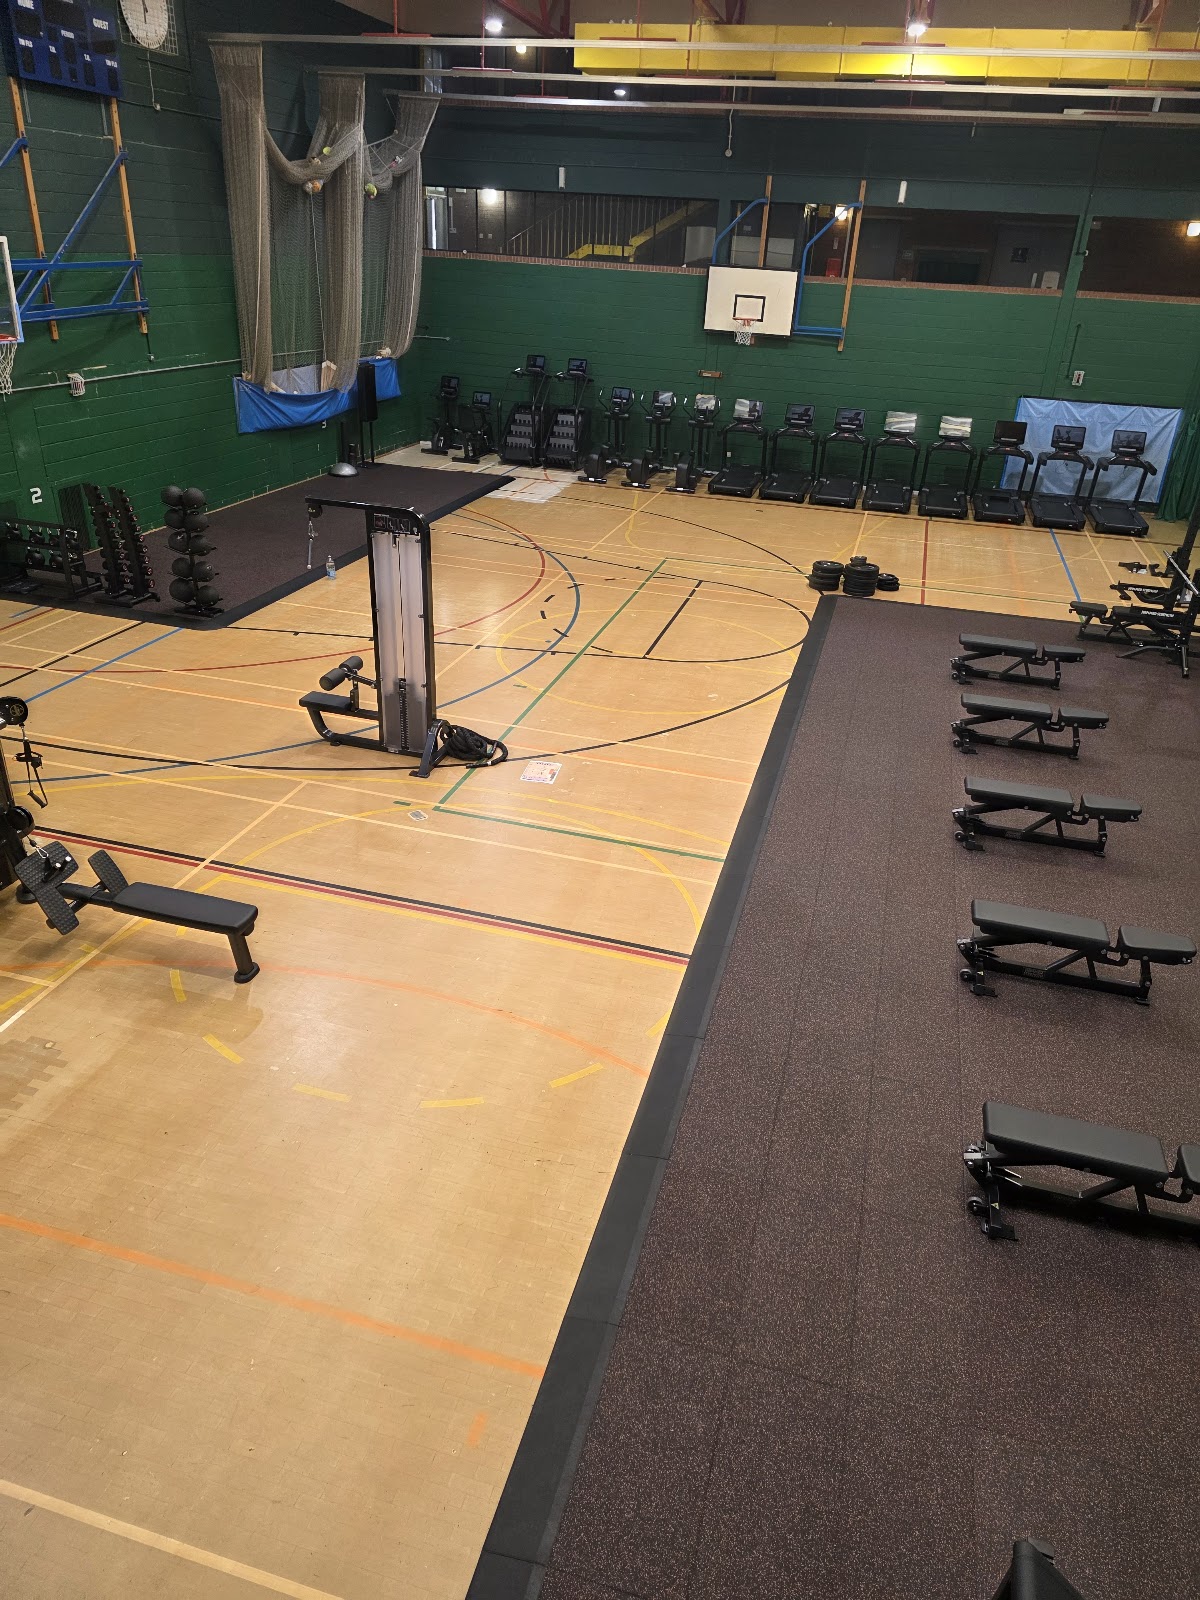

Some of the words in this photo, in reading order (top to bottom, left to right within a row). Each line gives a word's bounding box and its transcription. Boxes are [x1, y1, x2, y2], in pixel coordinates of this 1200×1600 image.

[93, 18, 108, 30] GUEST
[61, 30, 74, 39] PERIOD
[29, 487, 43, 505] 2
